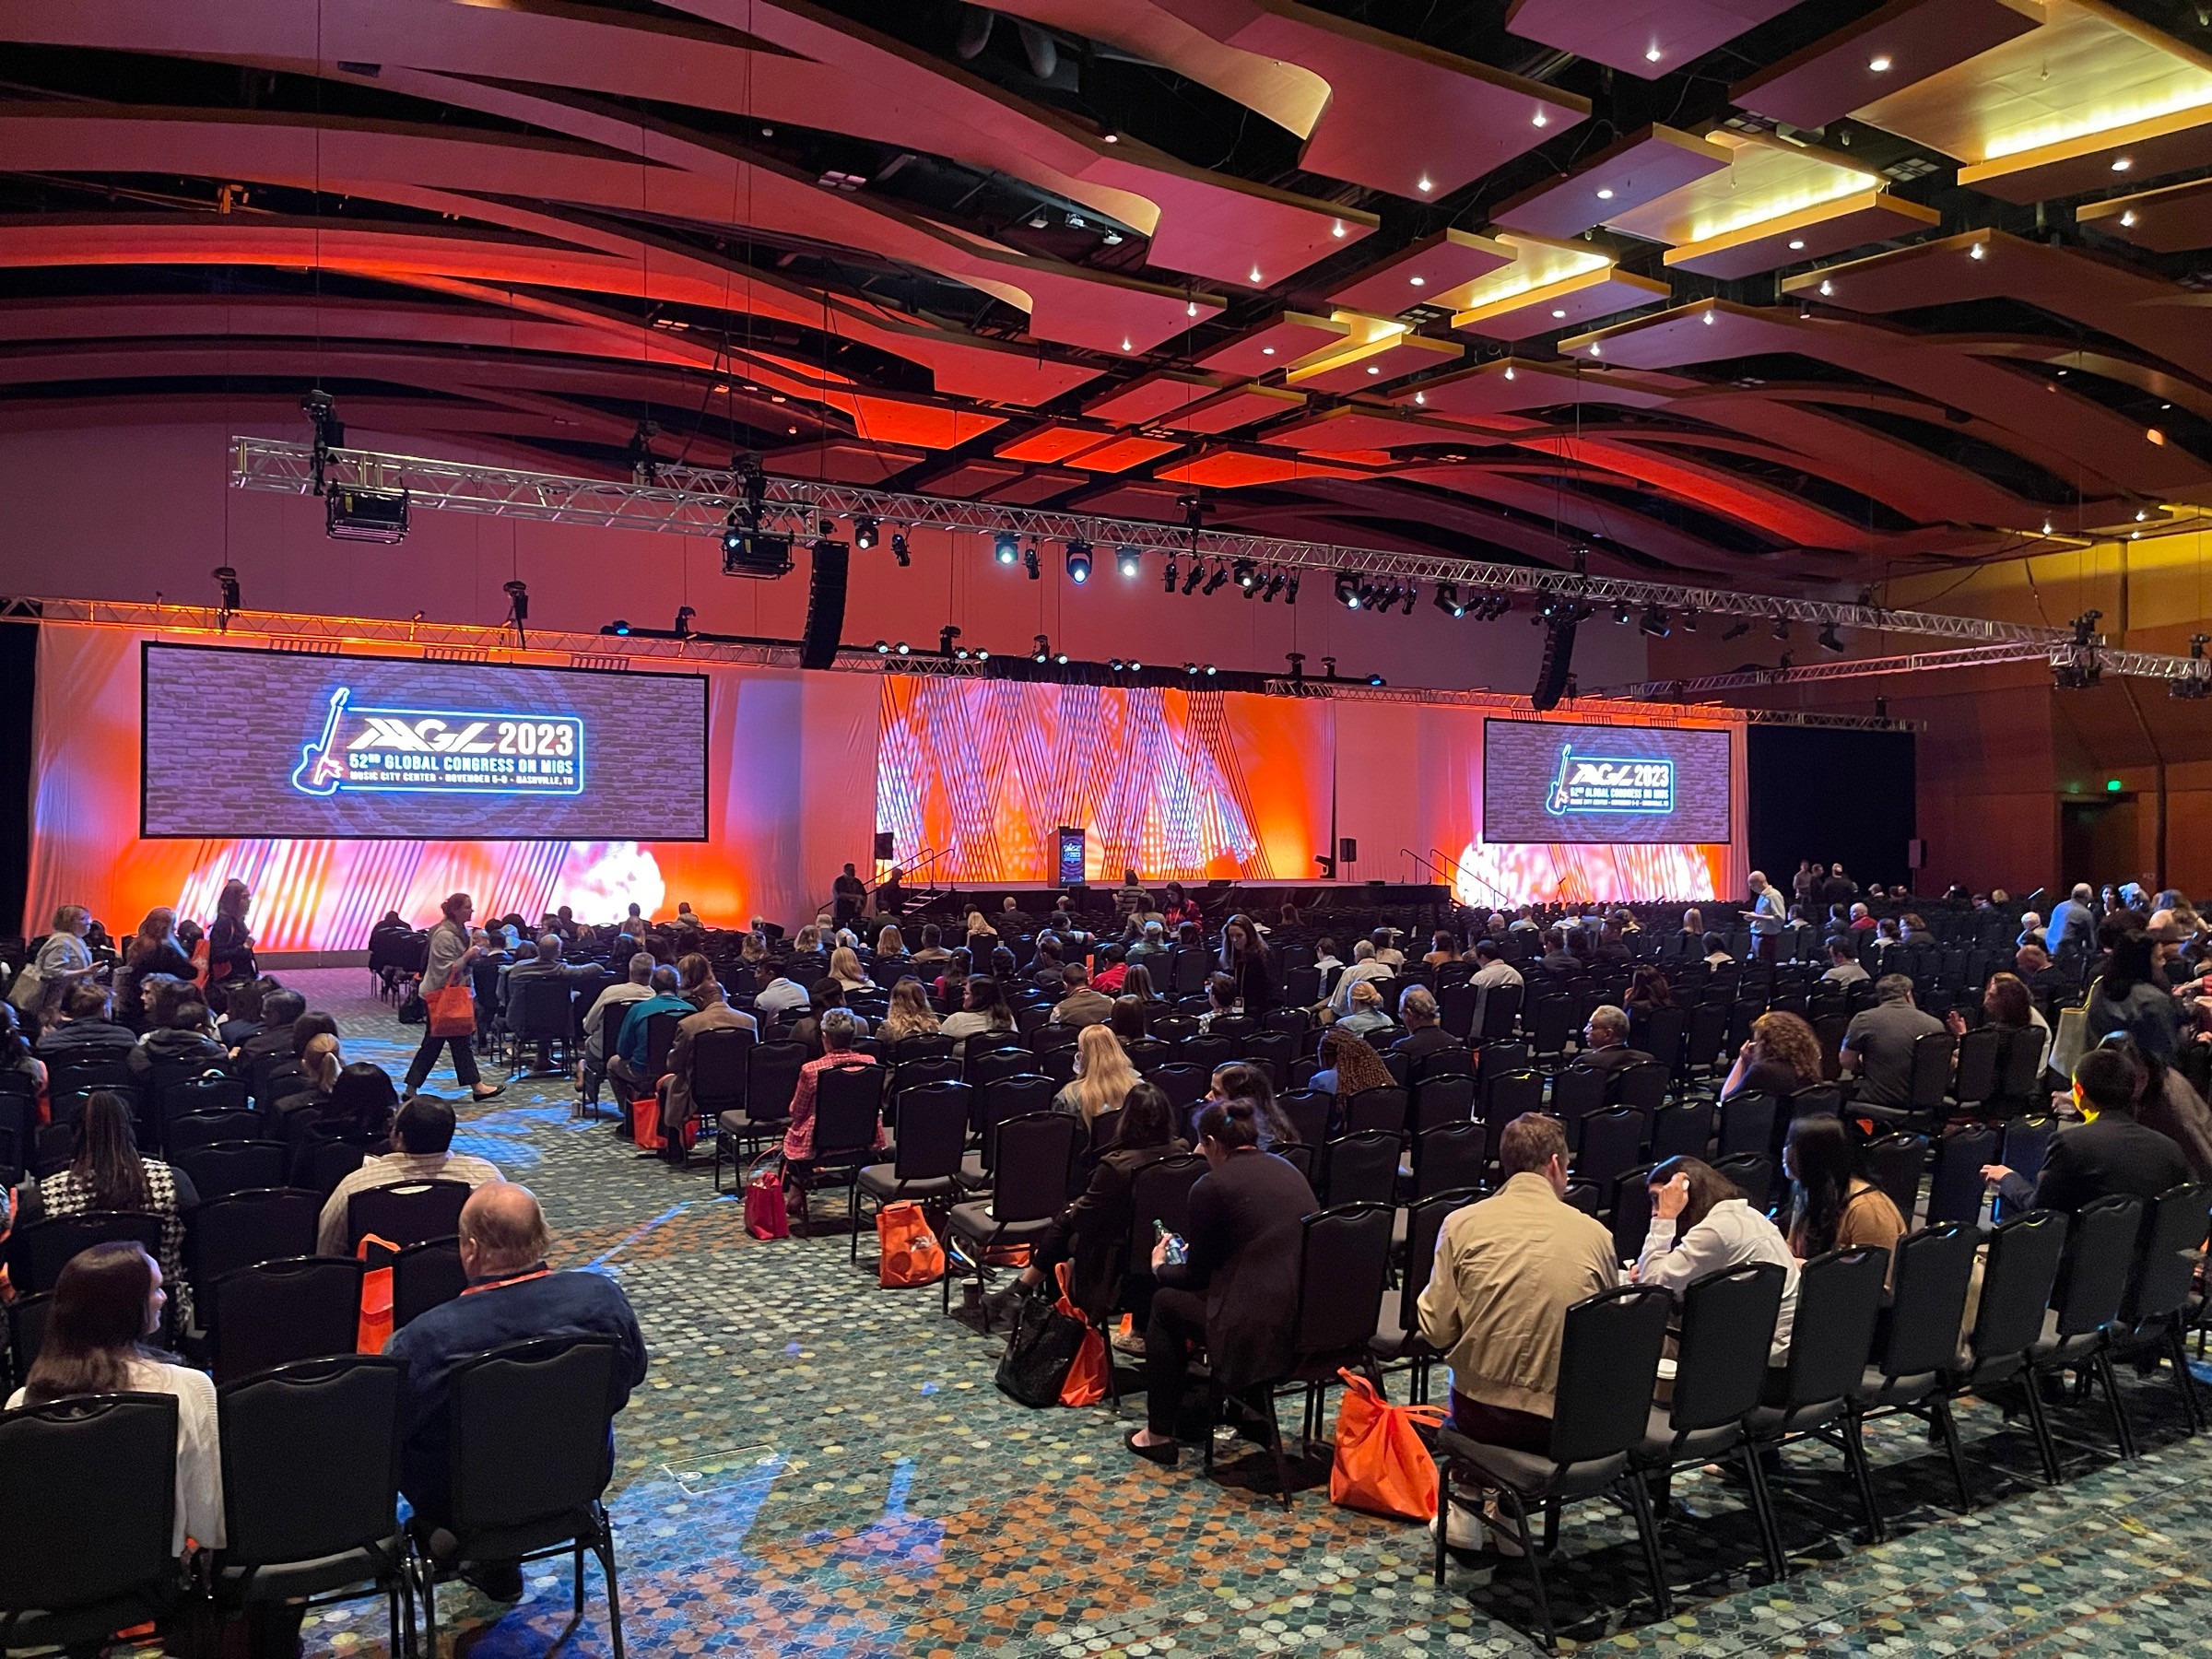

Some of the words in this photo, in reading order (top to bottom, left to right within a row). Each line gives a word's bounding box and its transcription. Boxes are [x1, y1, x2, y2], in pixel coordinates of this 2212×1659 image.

[498, 722, 573, 757] 2023
[349, 753, 381, 769] 52ND
[384, 754, 440, 771] GLOBAL
[443, 756, 514, 772] CONGRESS
[518, 759, 536, 773] ON
[541, 759, 573, 774] MIGS
[349, 771, 379, 781] MUSIC
[381, 771, 401, 782] CITY
[403, 772, 436, 782] CENTER
[444, 773, 490, 783] NOVEMBER
[1634, 764, 1669, 787] 2023
